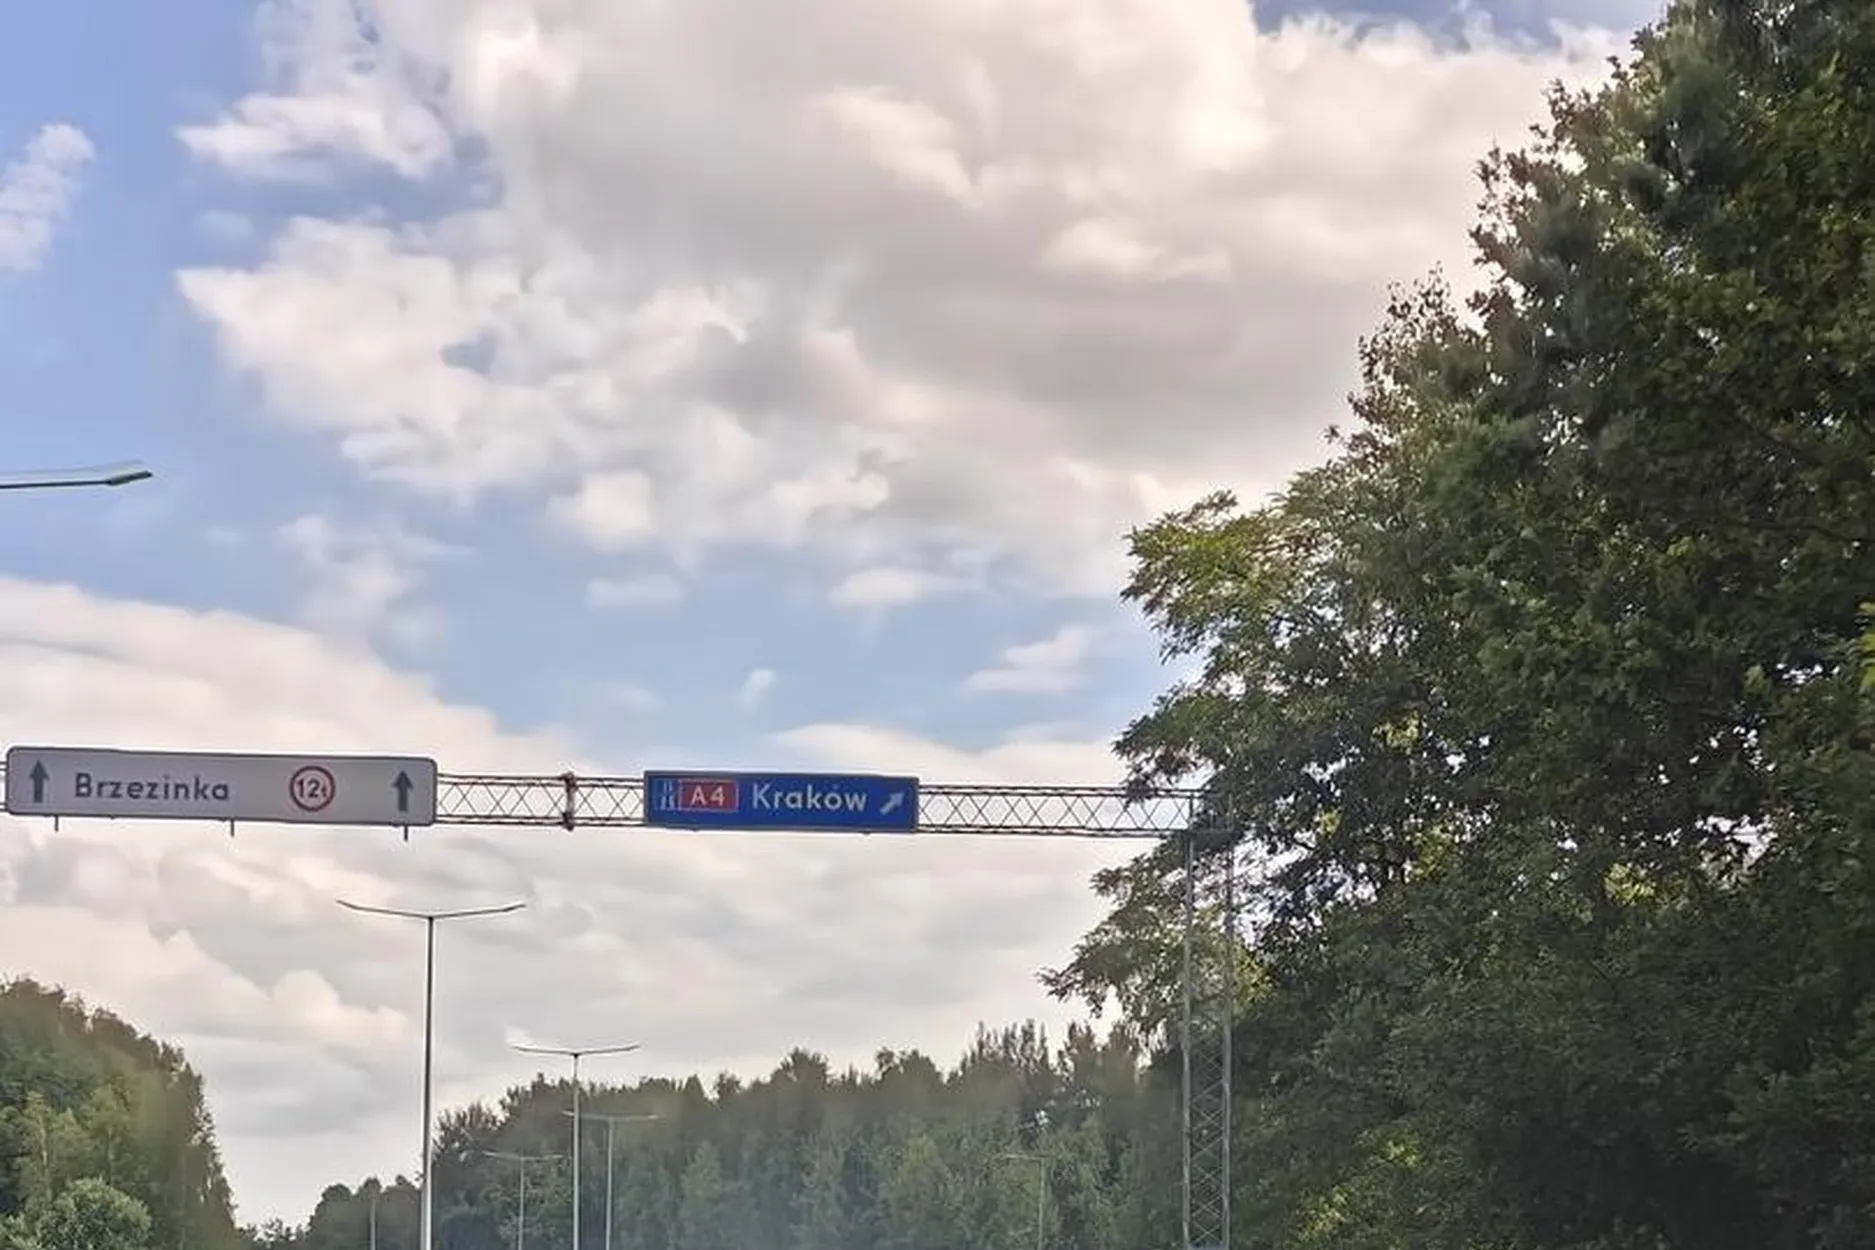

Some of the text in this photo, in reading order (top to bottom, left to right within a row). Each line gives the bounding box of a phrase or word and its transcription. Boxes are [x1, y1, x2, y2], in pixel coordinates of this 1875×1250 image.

[75, 773, 230, 801] Brzezinka
[690, 783, 867, 811] A4 Kraków
